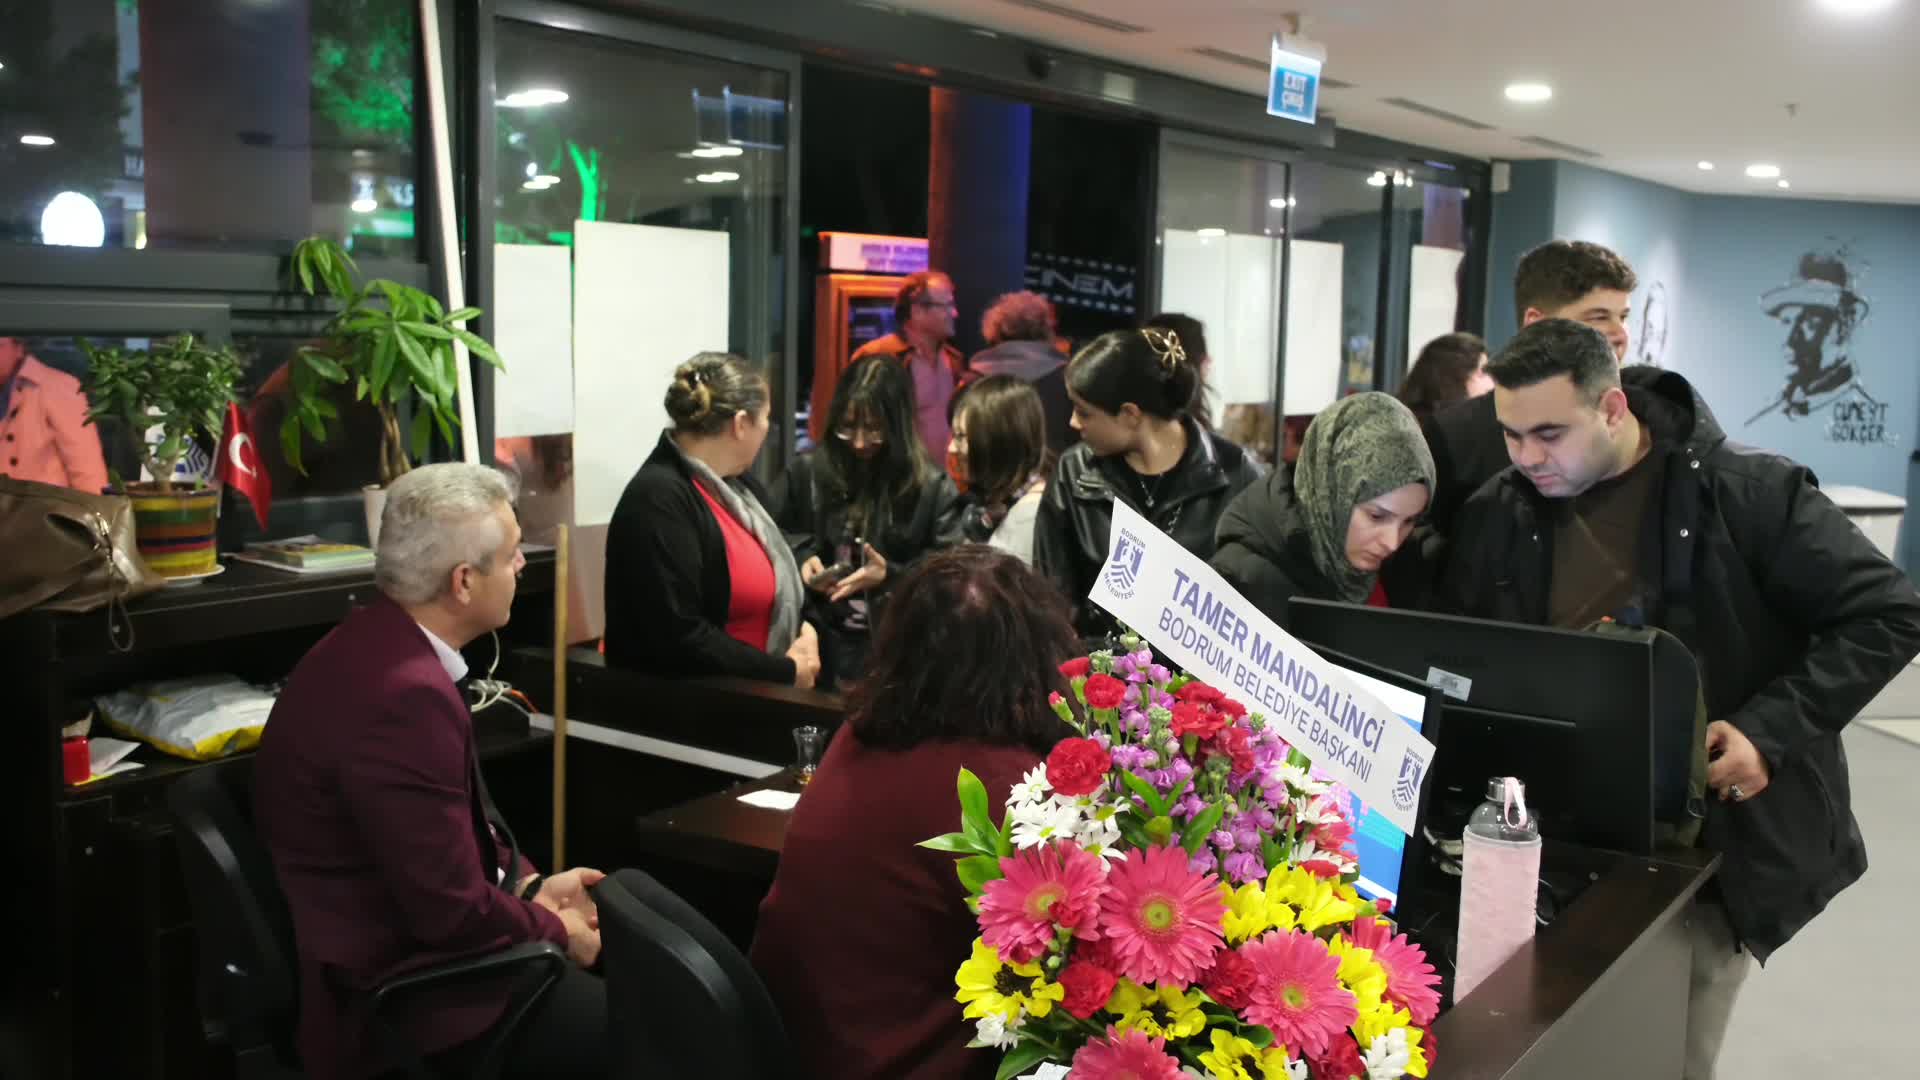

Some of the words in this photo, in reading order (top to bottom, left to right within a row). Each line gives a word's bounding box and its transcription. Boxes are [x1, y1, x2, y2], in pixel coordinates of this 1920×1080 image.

[1121, 527, 1146, 549] BODRUM
[1158, 607, 1233, 678] BODRUM
[1233, 664, 1311, 734] BELEDİYE
[1309, 720, 1373, 784] BAŞKANI
[1172, 568, 1249, 653] TAMER
[1250, 632, 1386, 754] MANDALİNCİ
